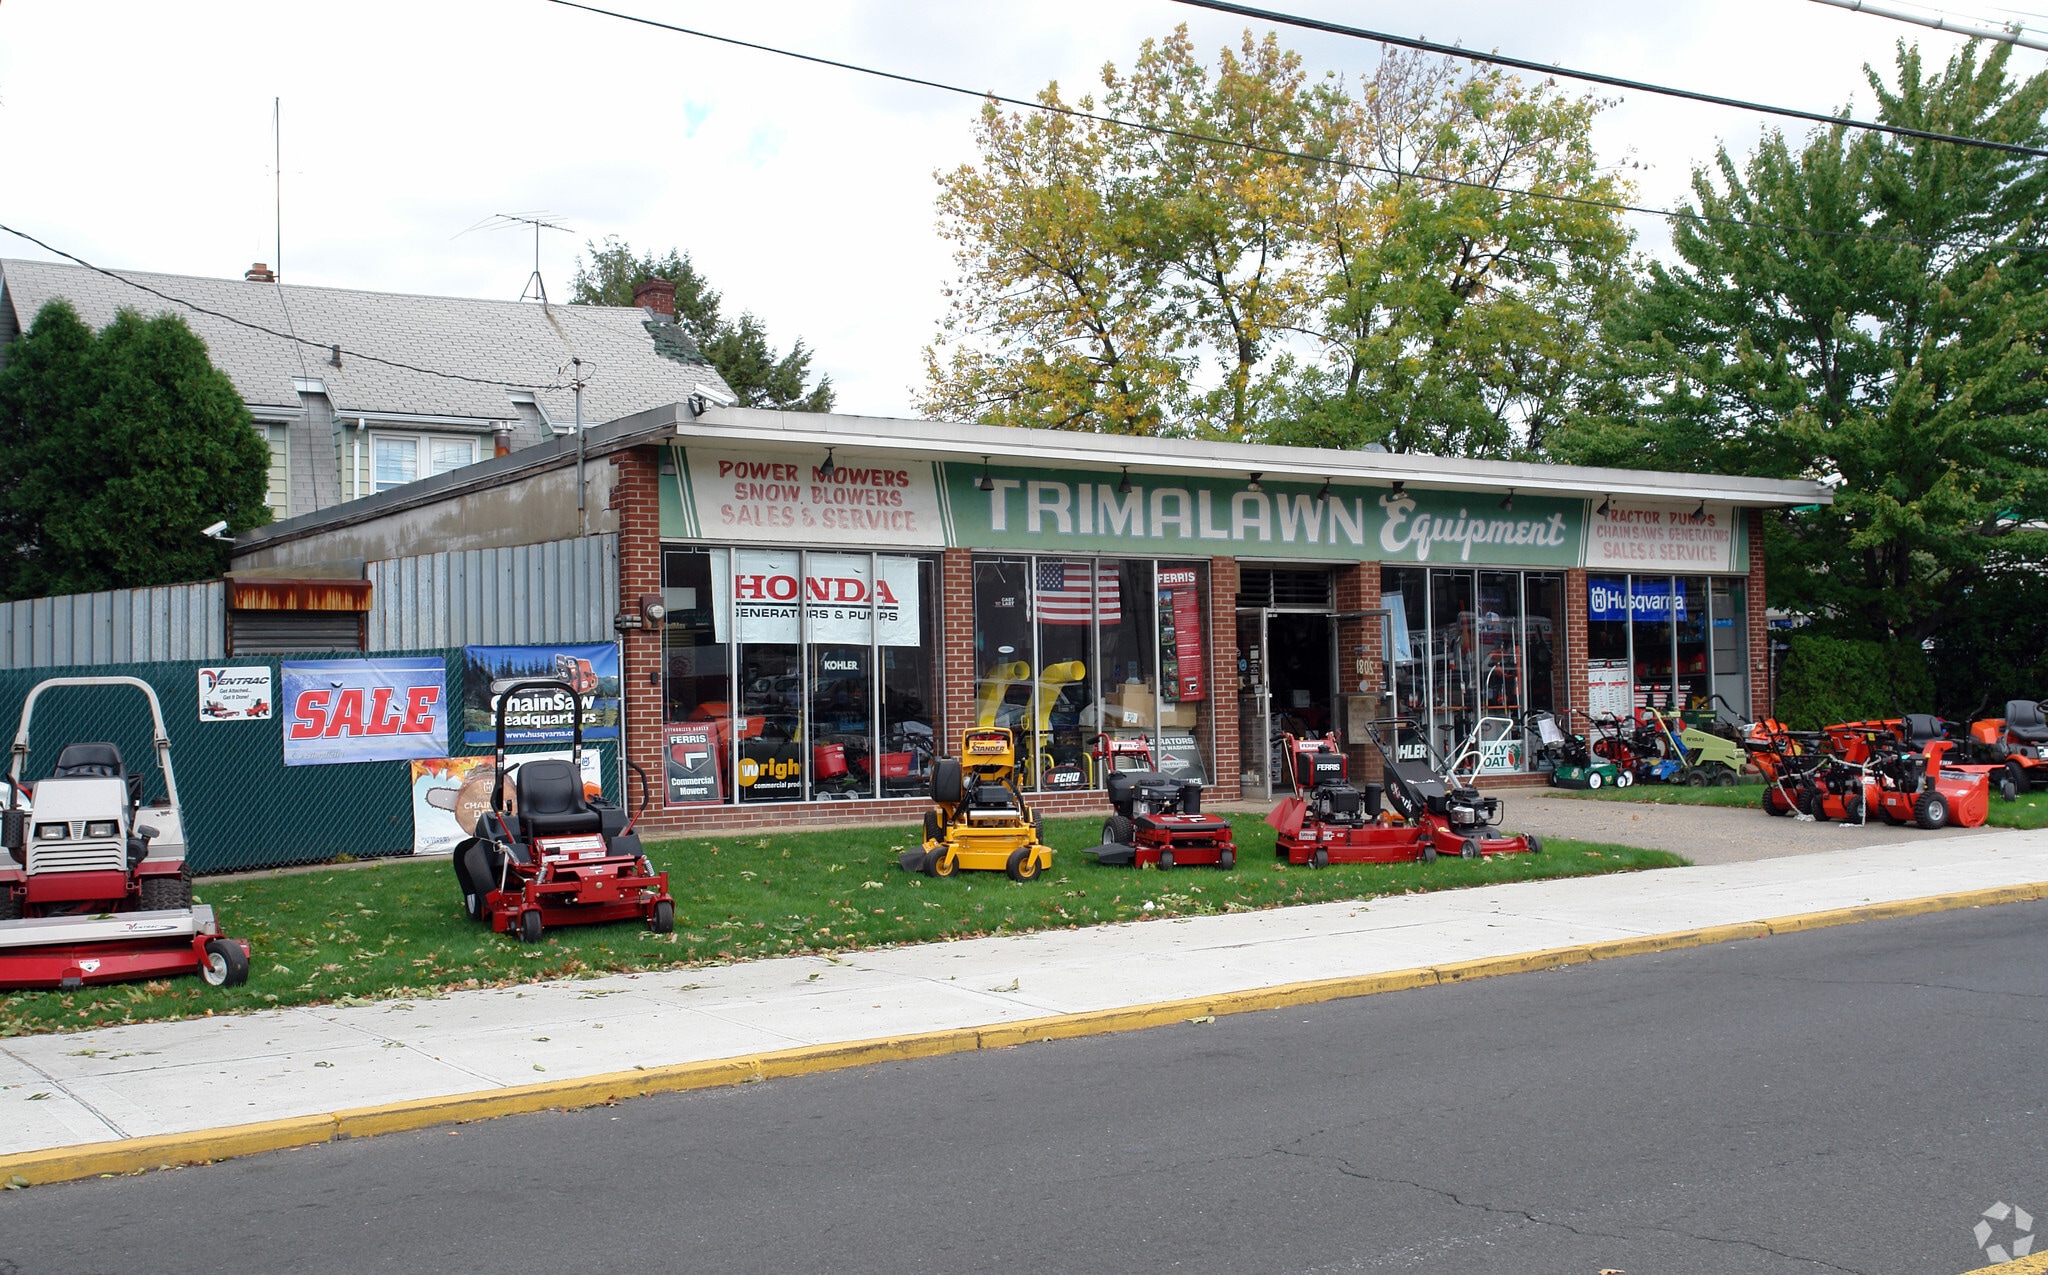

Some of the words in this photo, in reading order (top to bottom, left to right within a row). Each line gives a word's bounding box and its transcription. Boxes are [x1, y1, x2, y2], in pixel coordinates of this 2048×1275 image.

[718, 460, 798, 482] POWER
[812, 465, 909, 488] MOWERS
[735, 482, 801, 502] SNOW
[811, 485, 903, 507] BLOWERS
[721, 504, 795, 528] SALES
[801, 508, 817, 528] &
[822, 508, 918, 532] SERVICE
[974, 477, 1365, 546] TRIMALAWN
[1379, 494, 1567, 561] Equipment
[1669, 527, 1729, 542] GENERATORS
[1603, 541, 1647, 560] SALES
[1660, 543, 1717, 561] SERVICE
[1157, 572, 1196, 583] FERRIS
[735, 575, 898, 603] HONDA
[1607, 590, 1684, 612] Husqvarna
[735, 608, 829, 619] ENERATRS
[834, 610, 844, 619] &
[200, 670, 270, 695] VENTRAC
[288, 686, 441, 741] SALE
[490, 712, 597, 729] eadquartrs
[505, 731, 574, 739] www.husqvarna.co
[670, 735, 707, 744] FERRIS
[1482, 745, 1507, 756] ILLY
[741, 757, 801, 780] wrigh
[1316, 763, 1340, 771] FERRIS
[1483, 756, 1507, 767] OAT
[671, 775, 715, 786] Commercial
[1053, 771, 1080, 783] ECHO
[680, 787, 708, 796] Mowers
